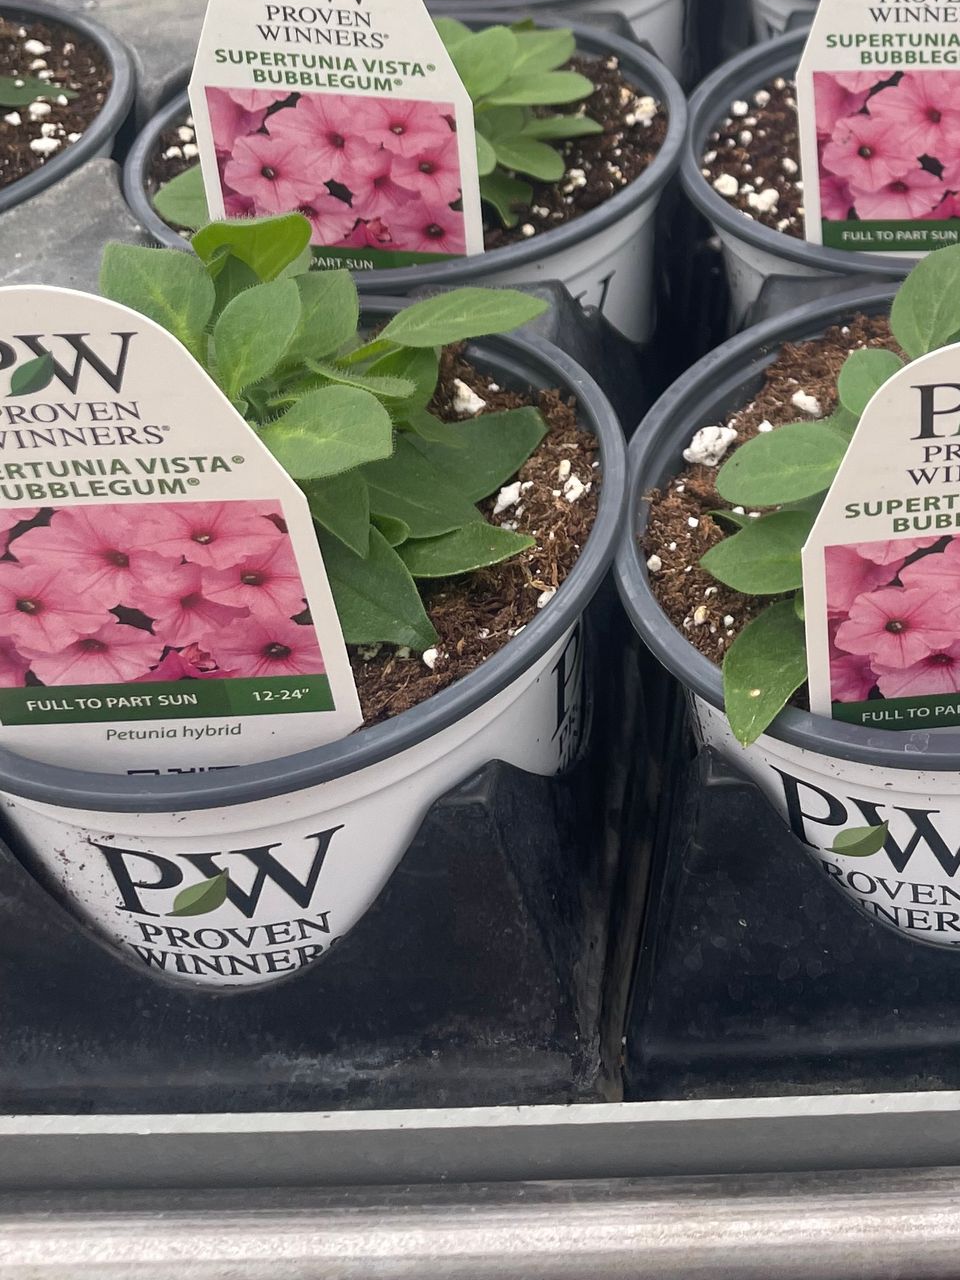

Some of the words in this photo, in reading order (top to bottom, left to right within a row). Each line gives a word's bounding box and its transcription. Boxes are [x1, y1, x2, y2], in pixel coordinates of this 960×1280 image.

[265, 5, 371, 28] PROVEN
[826, 33, 960, 48] SUPERTUNIA
[214, 49, 356, 71] SUPERTUNIA
[842, 231, 873, 241] FULL
[876, 231, 893, 240] TO
[897, 231, 928, 240] PART
[931, 230, 958, 240] SUN
[311, 257, 342, 268] PART
[347, 259, 373, 270] SUN
[0, 332, 139, 395] W
[0, 401, 141, 424] ROVEN
[0, 458, 130, 480] RTUNIA
[0, 477, 200, 501] UBBLEGUM®
[26, 699, 73, 712] FULL
[75, 697, 101, 710] TO
[107, 695, 152, 708] PART
[158, 693, 197, 706] SUN
[862, 707, 902, 722] FULL
[907, 706, 930, 720] TO
[107, 726, 177, 741] Petunia
[183, 723, 242, 740] hybrid
[88, 824, 345, 919] PW
[136, 911, 332, 950] PROVEN
[130, 935, 341, 976] WINNER
